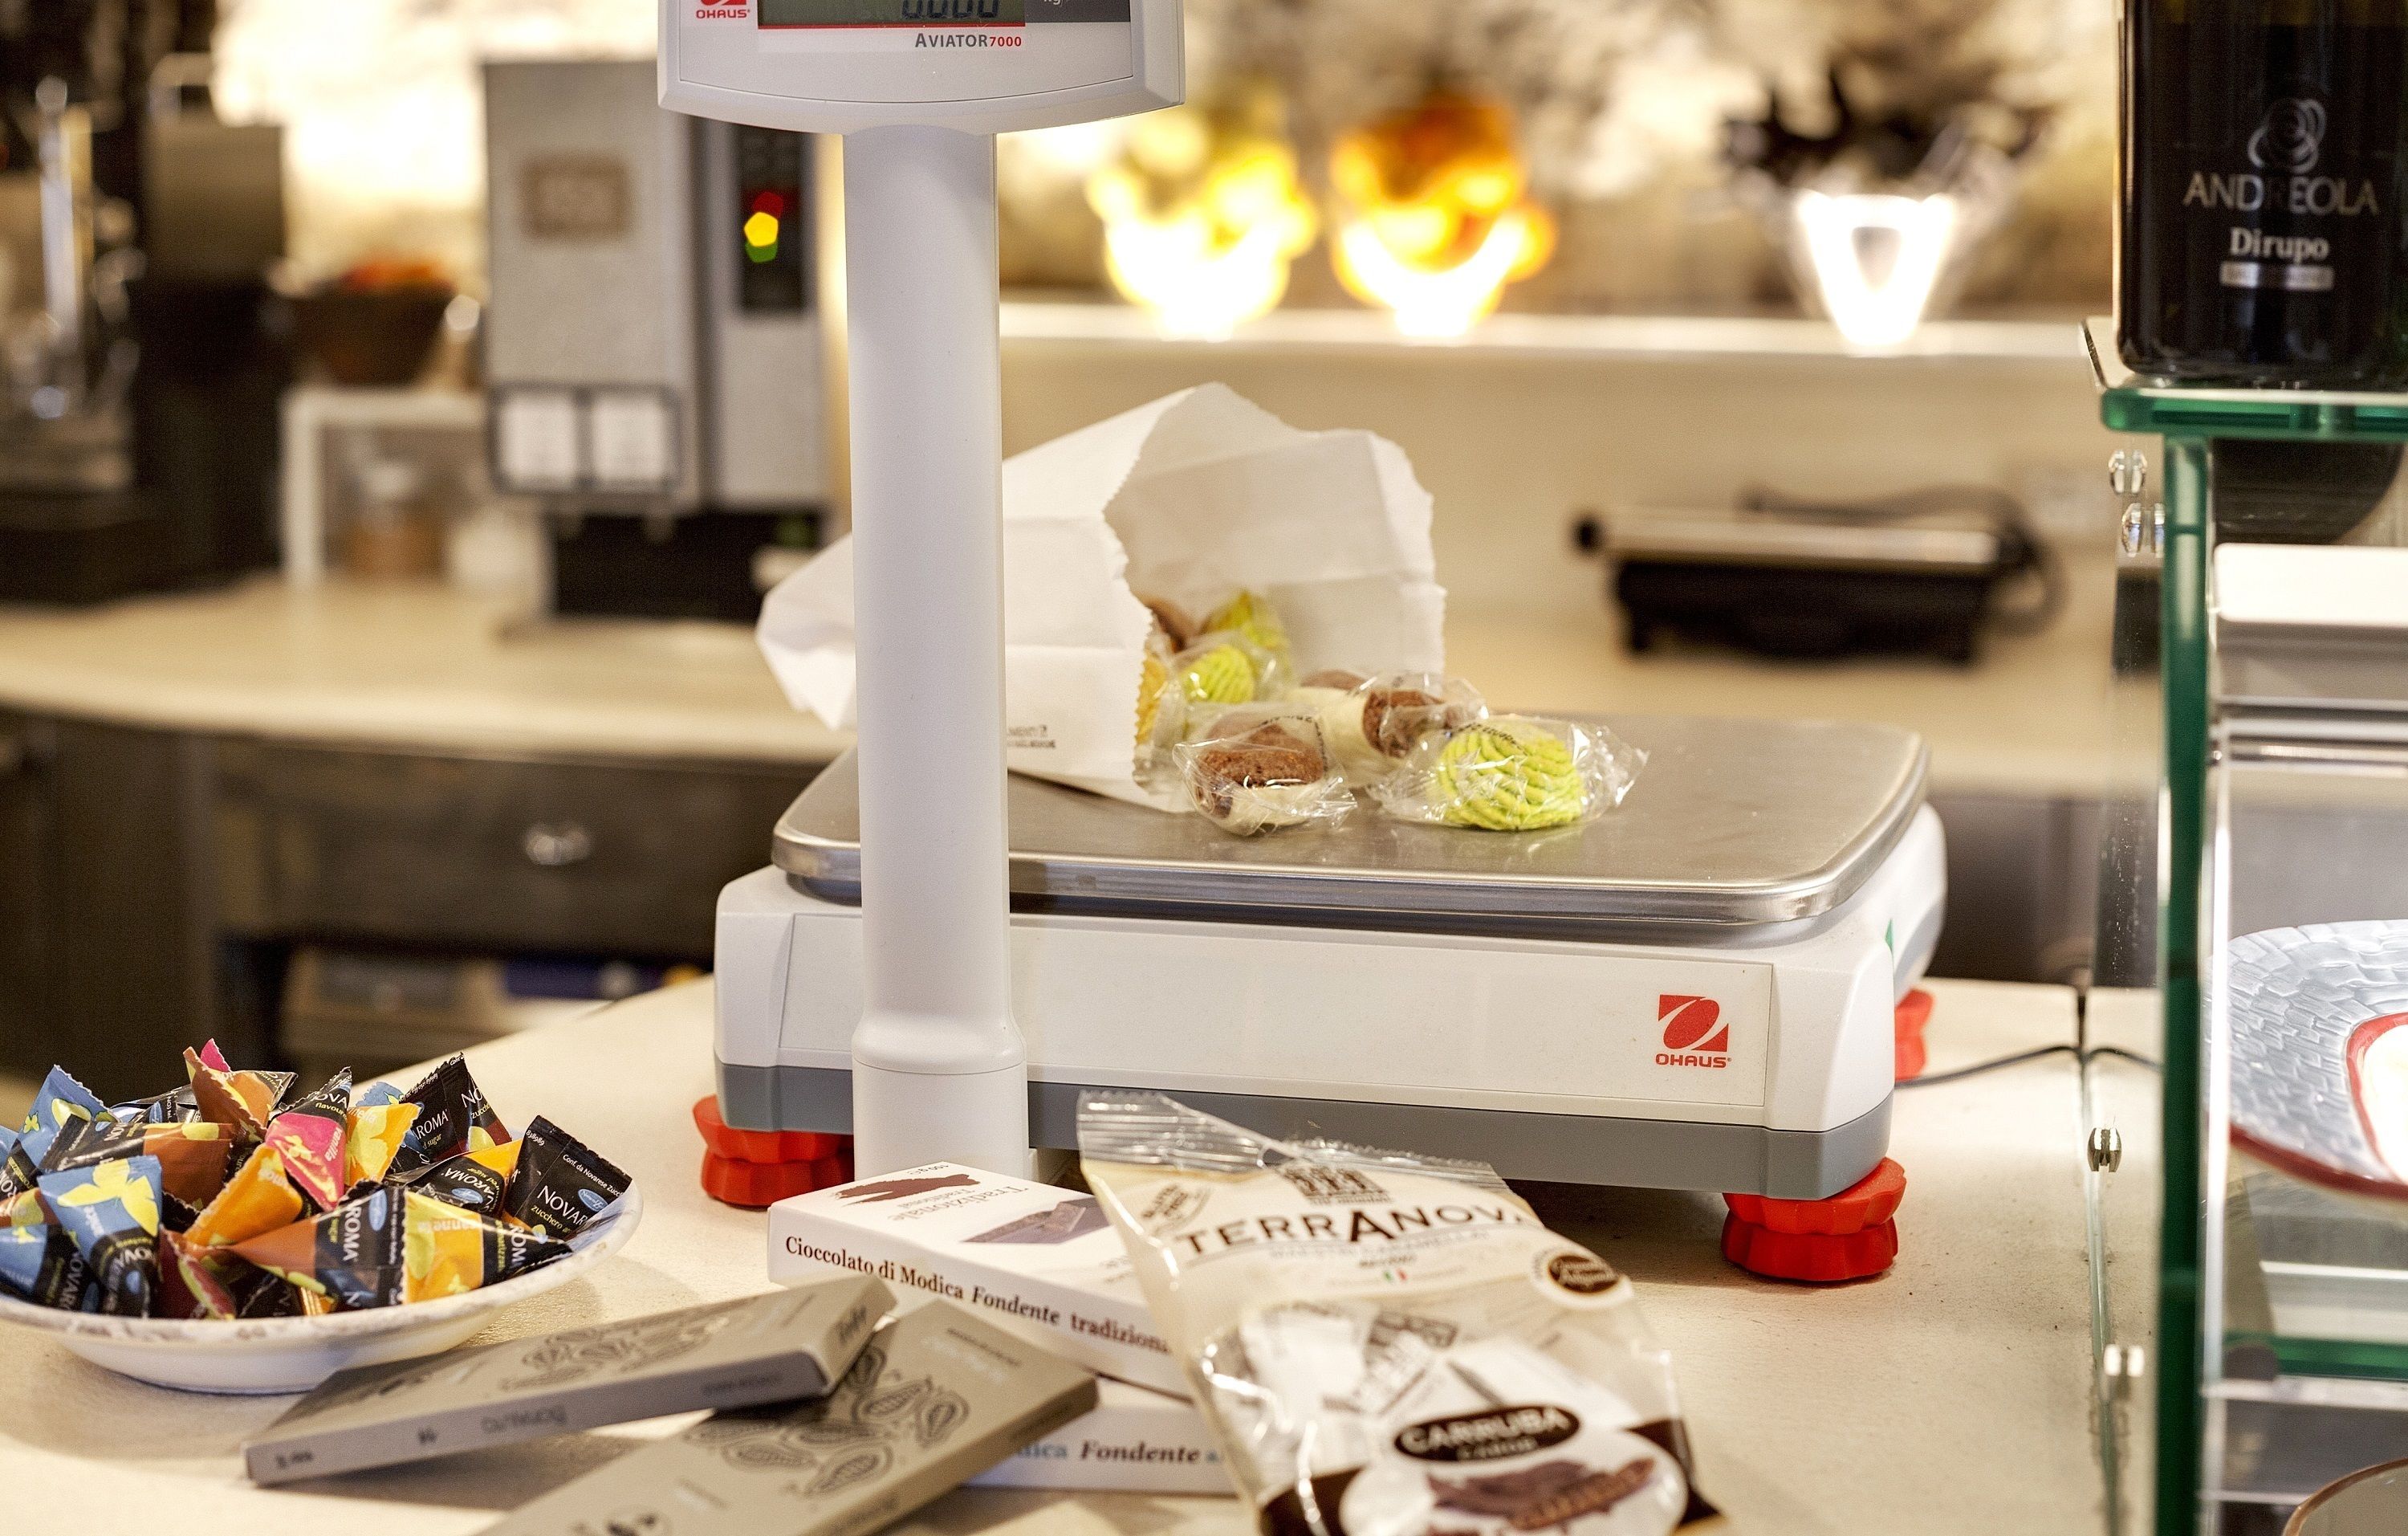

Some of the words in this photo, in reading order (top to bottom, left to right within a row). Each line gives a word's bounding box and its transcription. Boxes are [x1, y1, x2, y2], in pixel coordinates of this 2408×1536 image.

[696, 10, 747, 18] OHAUS
[2182, 170, 2380, 216] ANDEOLA
[2229, 226, 2330, 263] Dirupo
[1655, 1053, 1727, 1069] OHAUS
[324, 1127, 344, 1162] vanilla
[526, 1129, 545, 1147] 838989
[576, 1163, 584, 1172] da
[583, 1168, 608, 1188] Novarese
[531, 1204, 563, 1229] zucchero
[1174, 1206, 1523, 1254] TERRANOV
[786, 1236, 874, 1275] Cioccolato
[878, 1260, 895, 1281] di
[899, 1266, 964, 1299] Modica
[971, 1285, 1061, 1326] Fondente
[1080, 1439, 1202, 1464] Fondente
